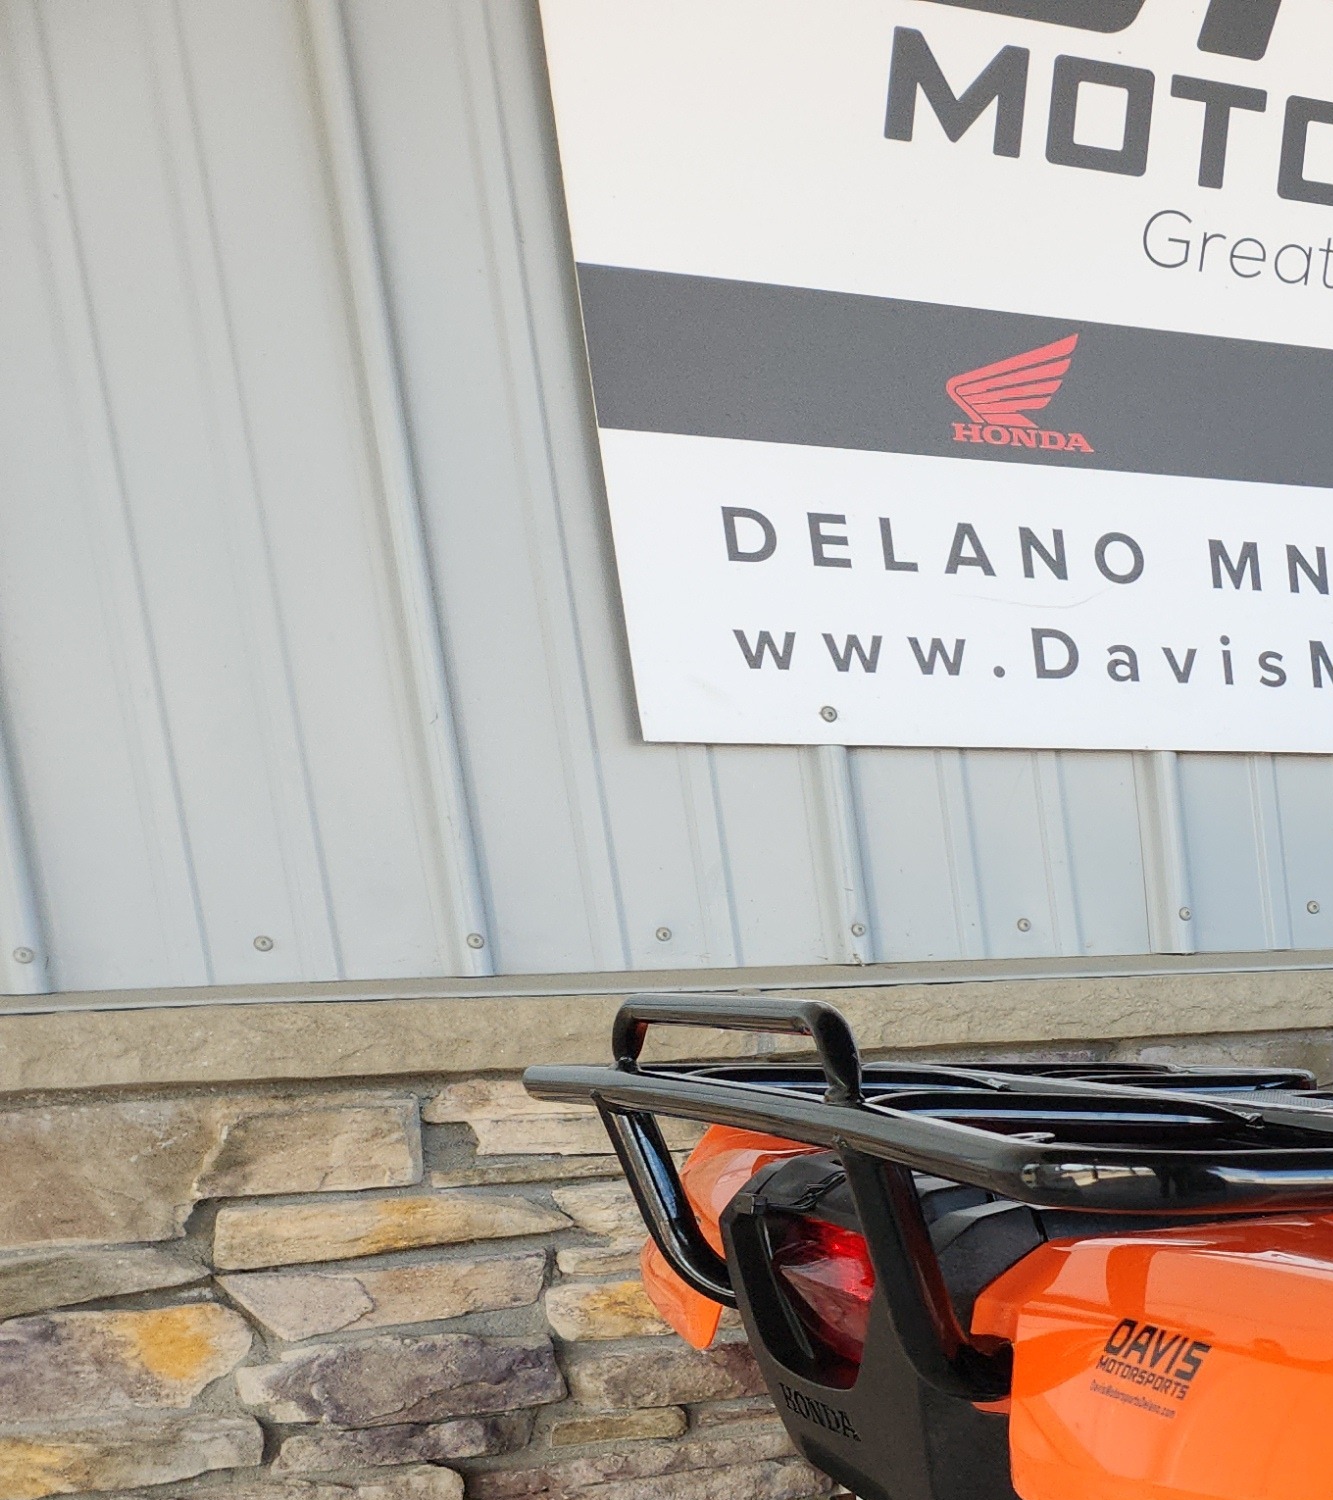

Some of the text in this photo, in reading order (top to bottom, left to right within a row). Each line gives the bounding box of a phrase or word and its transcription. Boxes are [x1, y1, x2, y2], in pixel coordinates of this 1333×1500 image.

[952, 422, 1094, 452] HONDA
[721, 506, 1144, 584] DELANO
[1209, 539, 1330, 596] MN
[1095, 1354, 1190, 1401] MOTORSPORTS
[1103, 1318, 1212, 1382] DAVIS
[779, 1382, 862, 1442] HONDA
